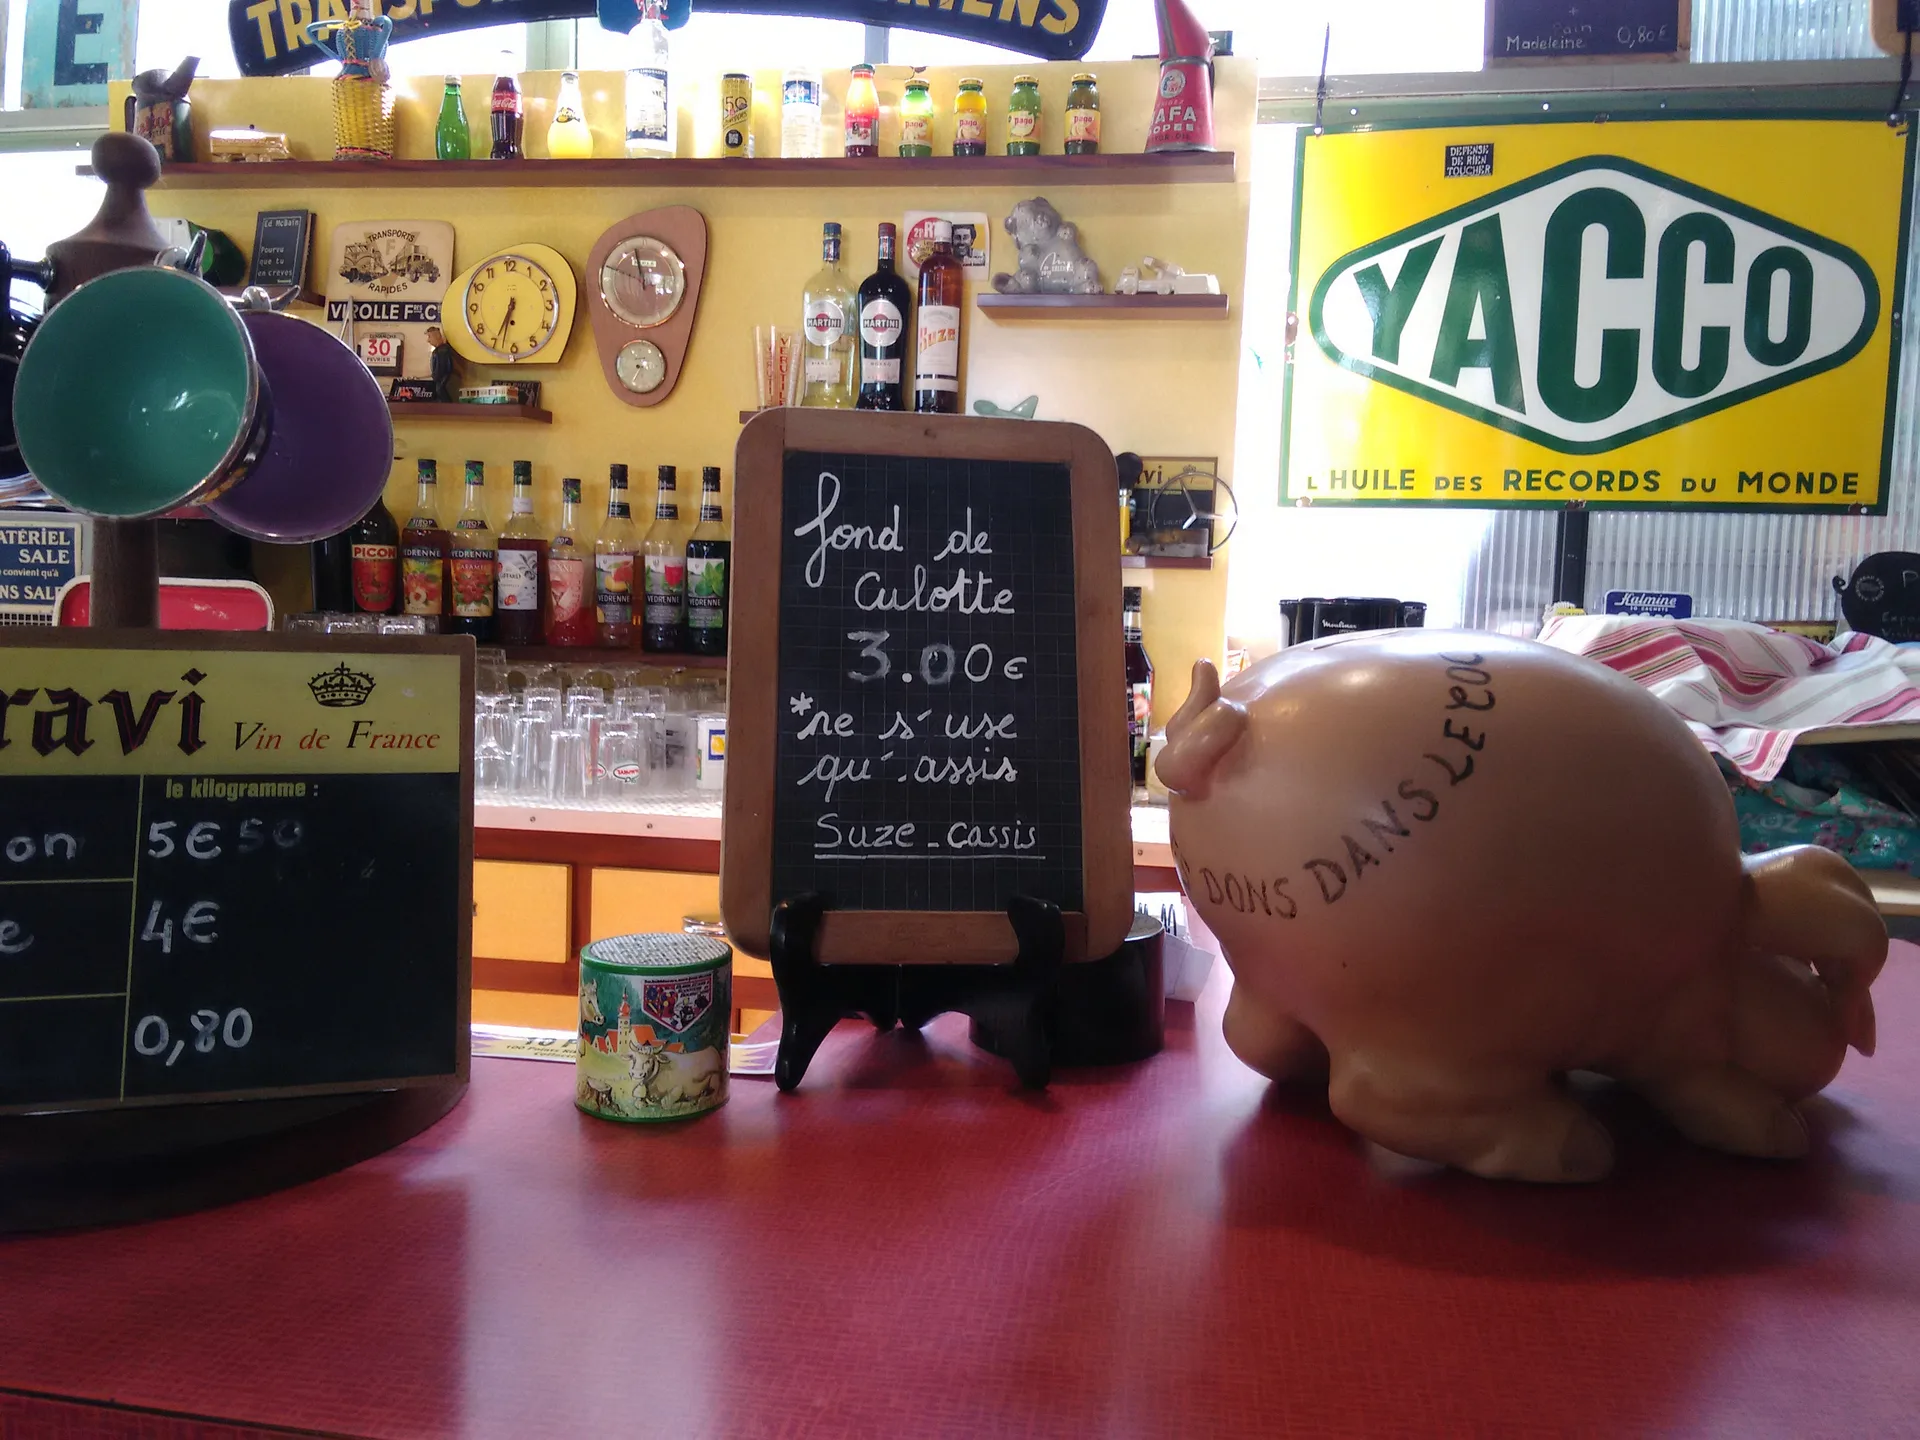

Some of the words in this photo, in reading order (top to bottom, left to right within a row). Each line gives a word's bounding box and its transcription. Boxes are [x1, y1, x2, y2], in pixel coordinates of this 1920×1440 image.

[1506, 35, 1584, 52] Madeleine
[905, 120, 924, 129] pago
[959, 119, 978, 128] pago
[1014, 117, 1033, 125] pago
[1074, 116, 1093, 124] pago
[1450, 145, 1489, 156] DEFENSE
[1452, 157, 1463, 166] DE
[1467, 155, 1487, 165] RIEN
[1447, 165, 1491, 176] TOUCHER
[276, 219, 299, 227] McBain
[368, 229, 415, 242] TRANSPORTS
[504, 261, 516, 272] 12
[527, 266, 532, 278] 1
[486, 268, 494, 279] 11
[368, 282, 408, 294] RAPIDES
[473, 283, 484, 294] 10
[540, 280, 547, 291] 2
[470, 303, 478, 314] 9
[545, 300, 553, 311] 3
[1354, 187, 1813, 423] YACCO
[542, 321, 550, 331] 4
[807, 318, 841, 328] MARTINI
[863, 319, 899, 328] MARTINI
[477, 324, 484, 334] 8
[368, 339, 390, 356] 30
[491, 338, 497, 349] 7
[529, 336, 537, 348] 5
[510, 343, 518, 354] 6
[1435, 476, 1482, 491] DES
[1503, 469, 1661, 492] RECORDS
[1681, 478, 1717, 493] DU
[1738, 471, 1858, 494] MONDE
[794, 472, 903, 588] fond
[933, 507, 993, 561] de
[18, 549, 70, 564] SALE
[354, 547, 396, 558] PICON
[451, 550, 493, 559] VEDRENNE
[3, 568, 39, 577] convient
[599, 594, 630, 602] VEDRENNE
[690, 598, 721, 606] VEDRENNE
[1614, 592, 1677, 608] Kalmine
[233, 720, 282, 750] Vin
[299, 727, 330, 750] de
[346, 720, 440, 750] France
[165, 778, 183, 798] le
[1200, 866, 1297, 919] DONS
[1303, 779, 1439, 905] DANS
[1422, 718, 1486, 786] LE
[814, 813, 915, 848] Suze
[5, 832, 78, 862] on
[0, 918, 35, 954] e
[140, 900, 221, 954] 4€
[134, 1007, 253, 1067] 0,80
